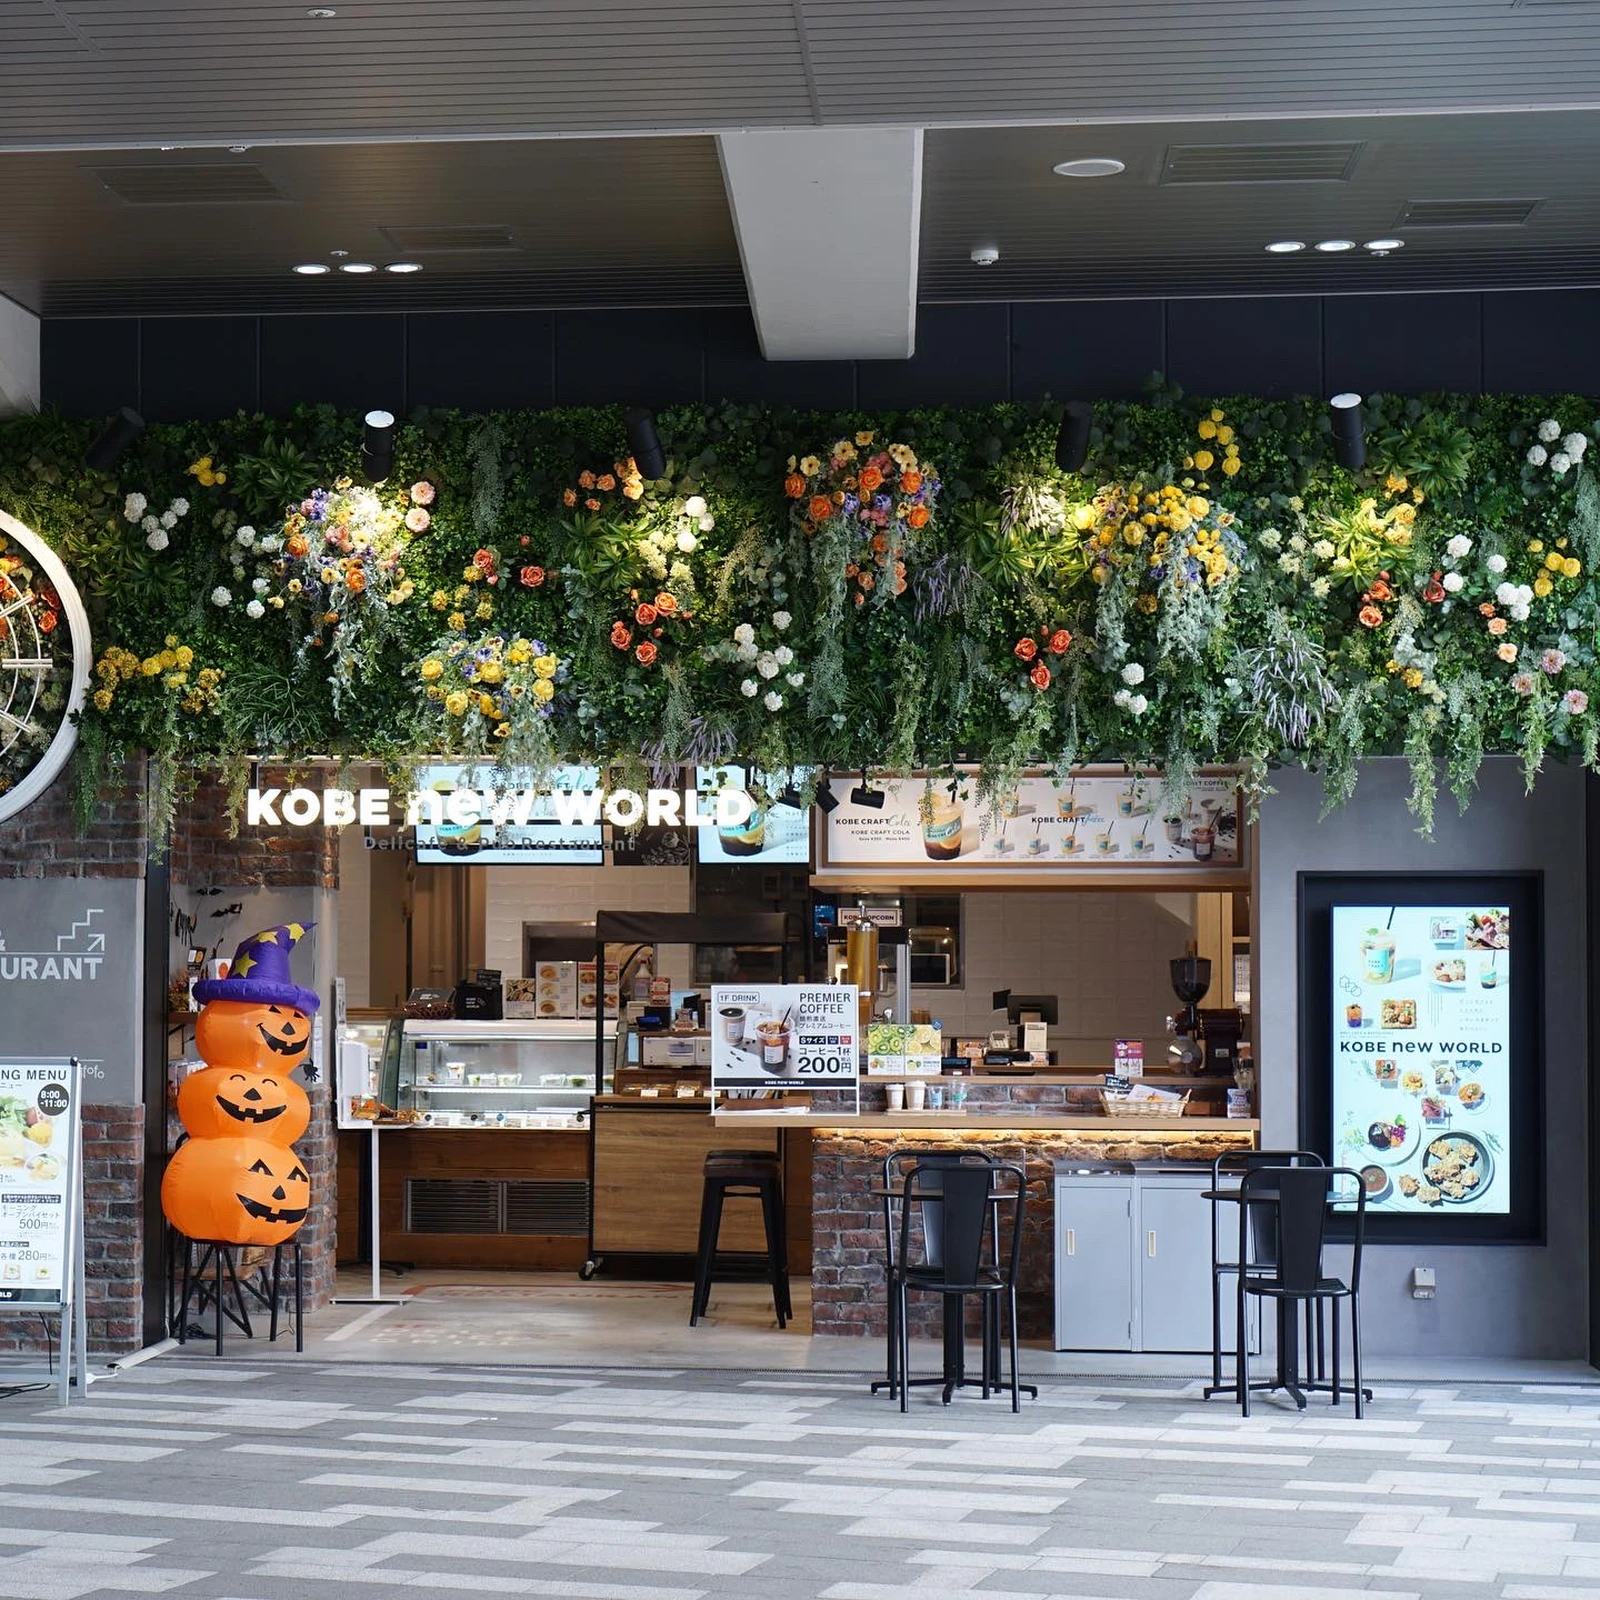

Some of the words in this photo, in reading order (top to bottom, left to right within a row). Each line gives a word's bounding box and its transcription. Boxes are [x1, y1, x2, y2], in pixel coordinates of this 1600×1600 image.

[247, 787, 390, 827] KOBE
[407, 786, 537, 827] new
[550, 787, 752, 827] WORLD
[835, 818, 860, 826] KOBE
[860, 818, 890, 826] CRAFT
[1031, 816, 1056, 824] KOBE
[1056, 816, 1086, 824] CRAFT
[456, 836, 469, 850] &
[520, 836, 636, 851] Restaurant
[0, 957, 103, 980] URANT
[720, 994, 730, 1002] 1F
[731, 994, 758, 1002] DRINK
[799, 992, 852, 1003] PREMIER
[799, 1003, 844, 1014] COFFEE
[800, 1036, 825, 1044] Sサイズ
[799, 1046, 852, 1056] コーヒー1杯
[1340, 1041, 1386, 1053] KOBE
[1392, 1041, 1433, 1053] new
[1439, 1042, 1502, 1053] WORLD
[1, 1069, 21, 1080] NG
[26, 1069, 67, 1080] MENU
[40, 1090, 60, 1099] 8:00
